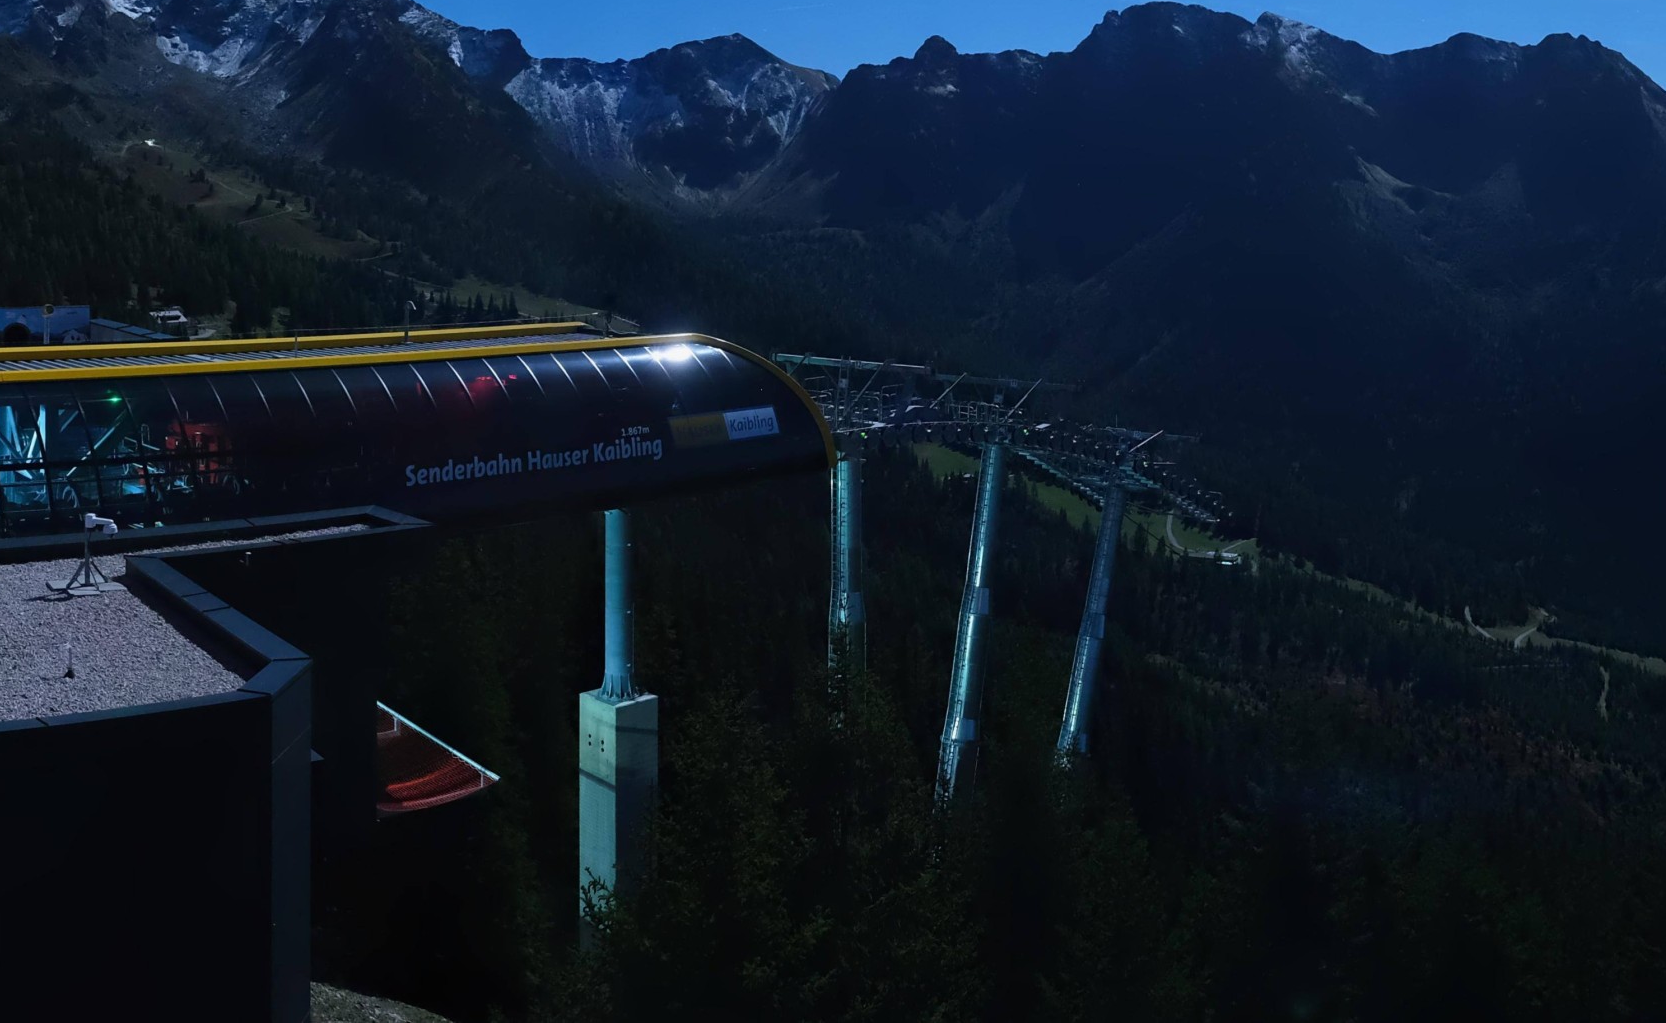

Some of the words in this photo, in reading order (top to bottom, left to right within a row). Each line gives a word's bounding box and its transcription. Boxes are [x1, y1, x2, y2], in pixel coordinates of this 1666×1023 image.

[620, 425, 650, 437] 1.867m
[729, 413, 775, 434] Kaibling
[405, 454, 523, 487] Senderbahn
[527, 446, 590, 472] Hauser
[592, 435, 664, 463] Kaibling
